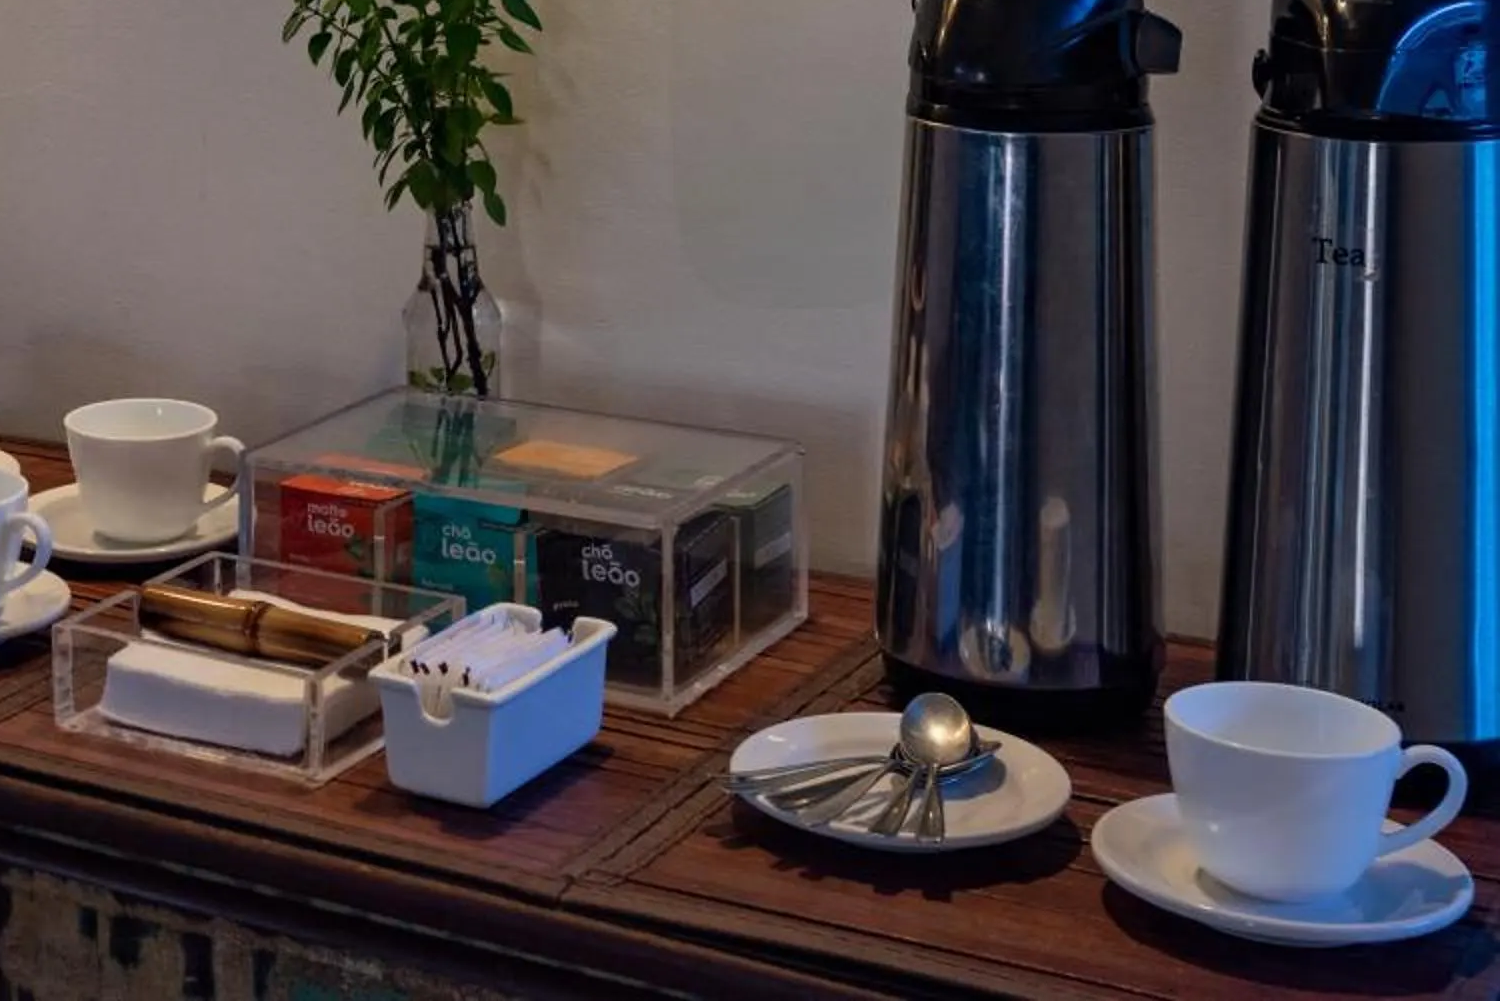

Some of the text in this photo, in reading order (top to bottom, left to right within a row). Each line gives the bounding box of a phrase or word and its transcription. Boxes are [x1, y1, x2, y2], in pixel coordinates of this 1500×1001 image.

[1311, 237, 1365, 267] Tea
[308, 514, 355, 538] leão
[442, 537, 497, 565] leão
[581, 559, 641, 588] leão
